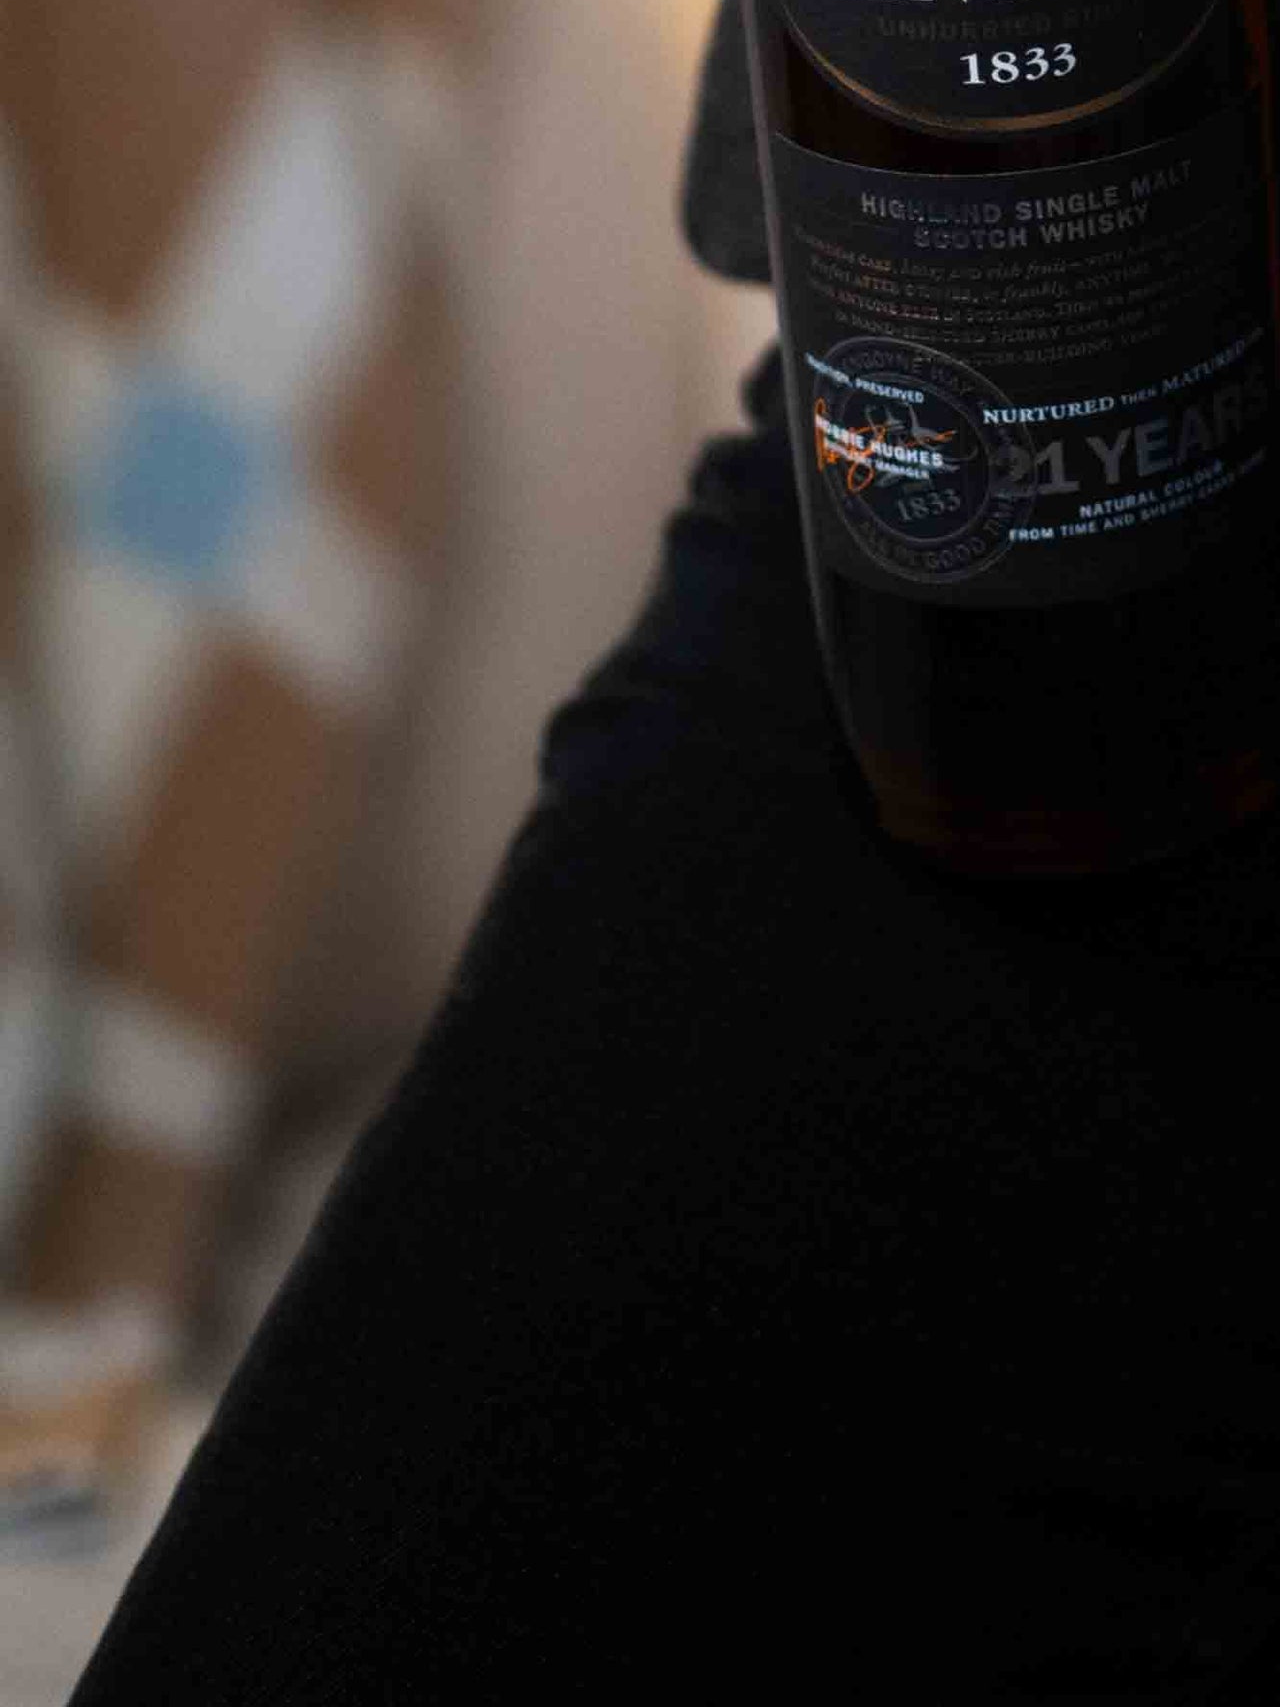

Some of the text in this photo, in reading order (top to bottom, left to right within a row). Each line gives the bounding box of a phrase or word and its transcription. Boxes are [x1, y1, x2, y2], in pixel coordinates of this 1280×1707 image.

[959, 42, 1078, 85] 1833
[860, 159, 1192, 225] HIGHLAND SINGLE MALT
[912, 227, 1029, 250] SCOTCH
[1040, 202, 1150, 245] WHISKY
[982, 394, 1115, 426] NURTURED
[1161, 339, 1246, 393] MATURED
[895, 487, 962, 524] 1833
[1079, 486, 1157, 520] NATURAL
[1008, 526, 1054, 543] FROM
[1060, 520, 1098, 537] TIME
[1103, 513, 1136, 532] AND
